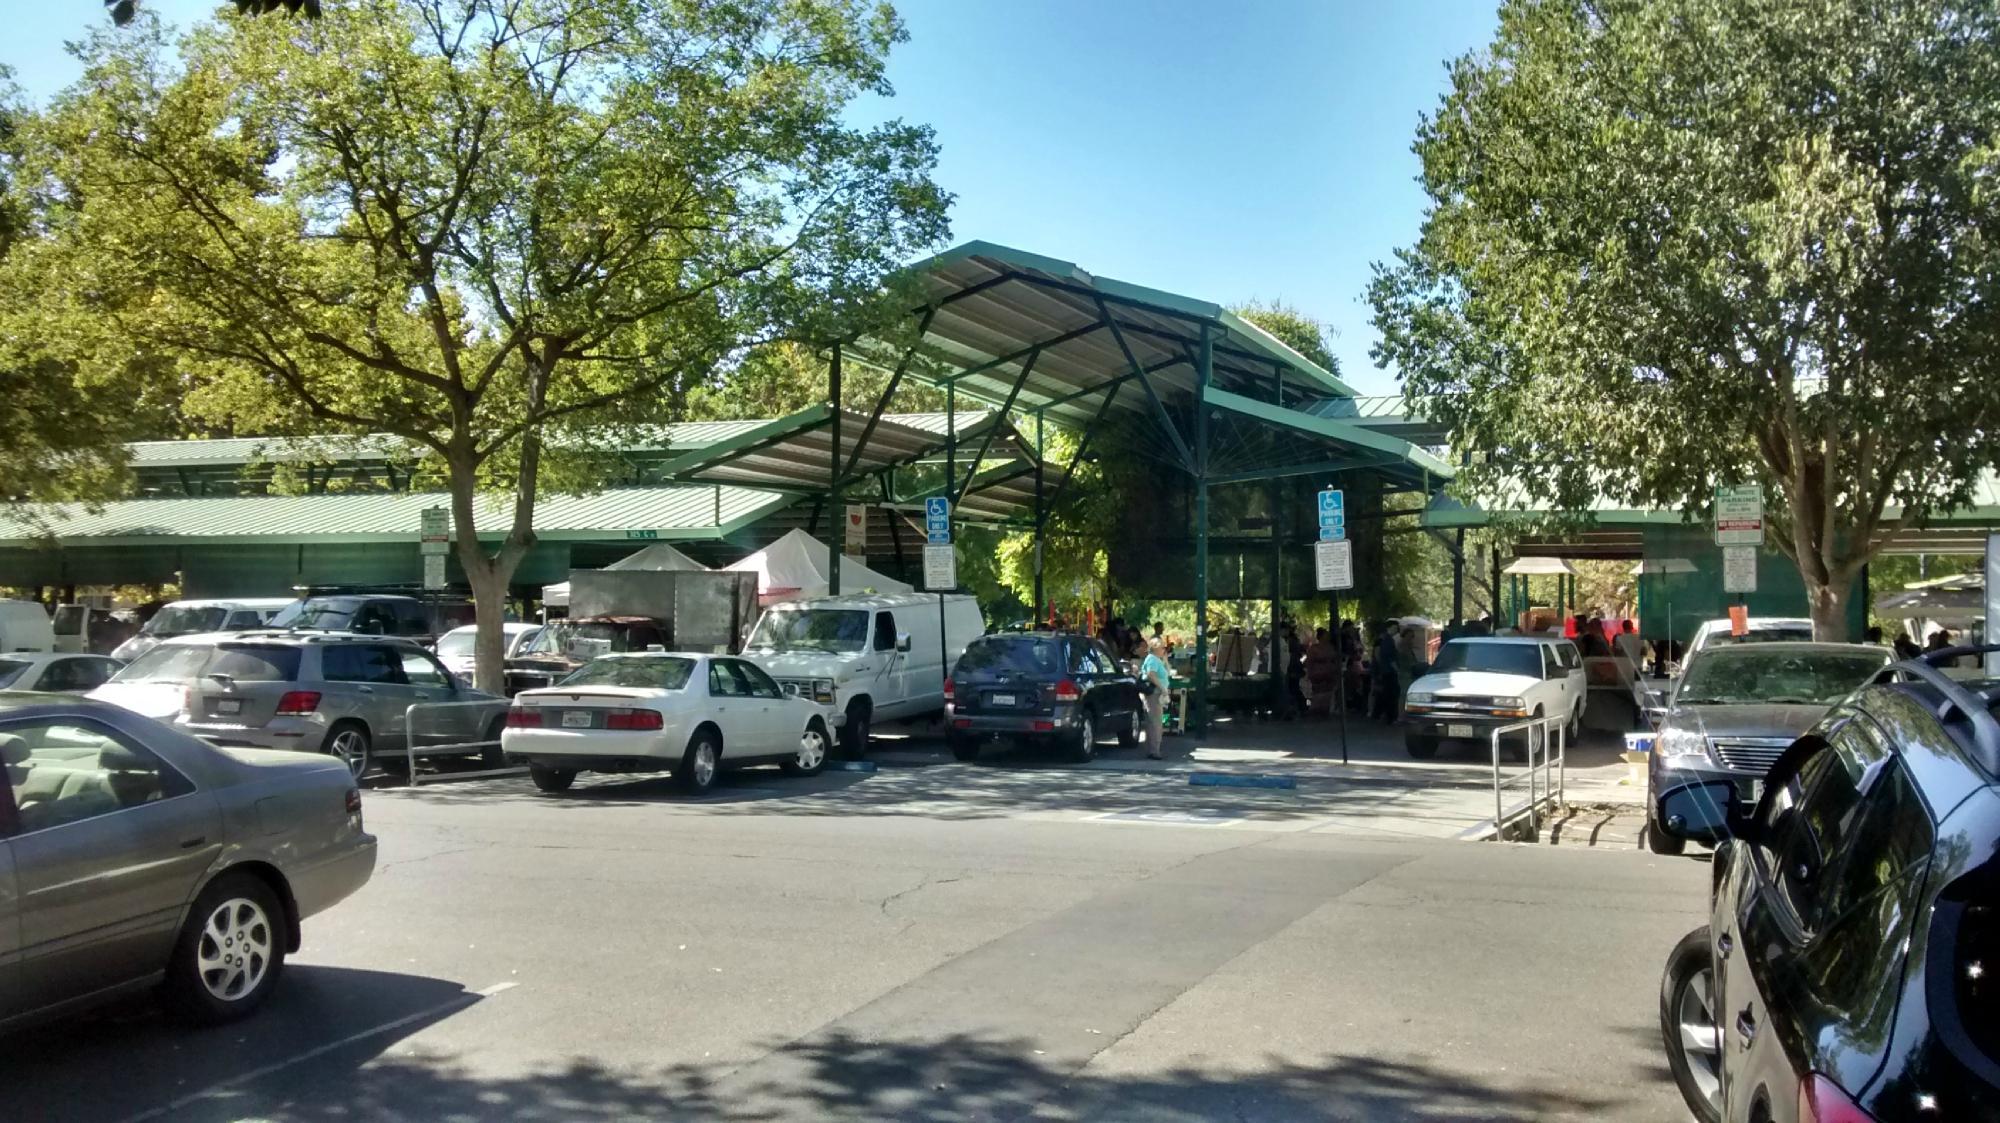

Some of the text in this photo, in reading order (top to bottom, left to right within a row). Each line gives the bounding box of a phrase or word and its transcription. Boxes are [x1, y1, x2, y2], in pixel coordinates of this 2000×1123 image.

[1320, 509, 1343, 518] PARKING
[928, 514, 947, 522] PARKING
[1325, 518, 1339, 526] ONLY
[932, 522, 944, 530] ONLY
